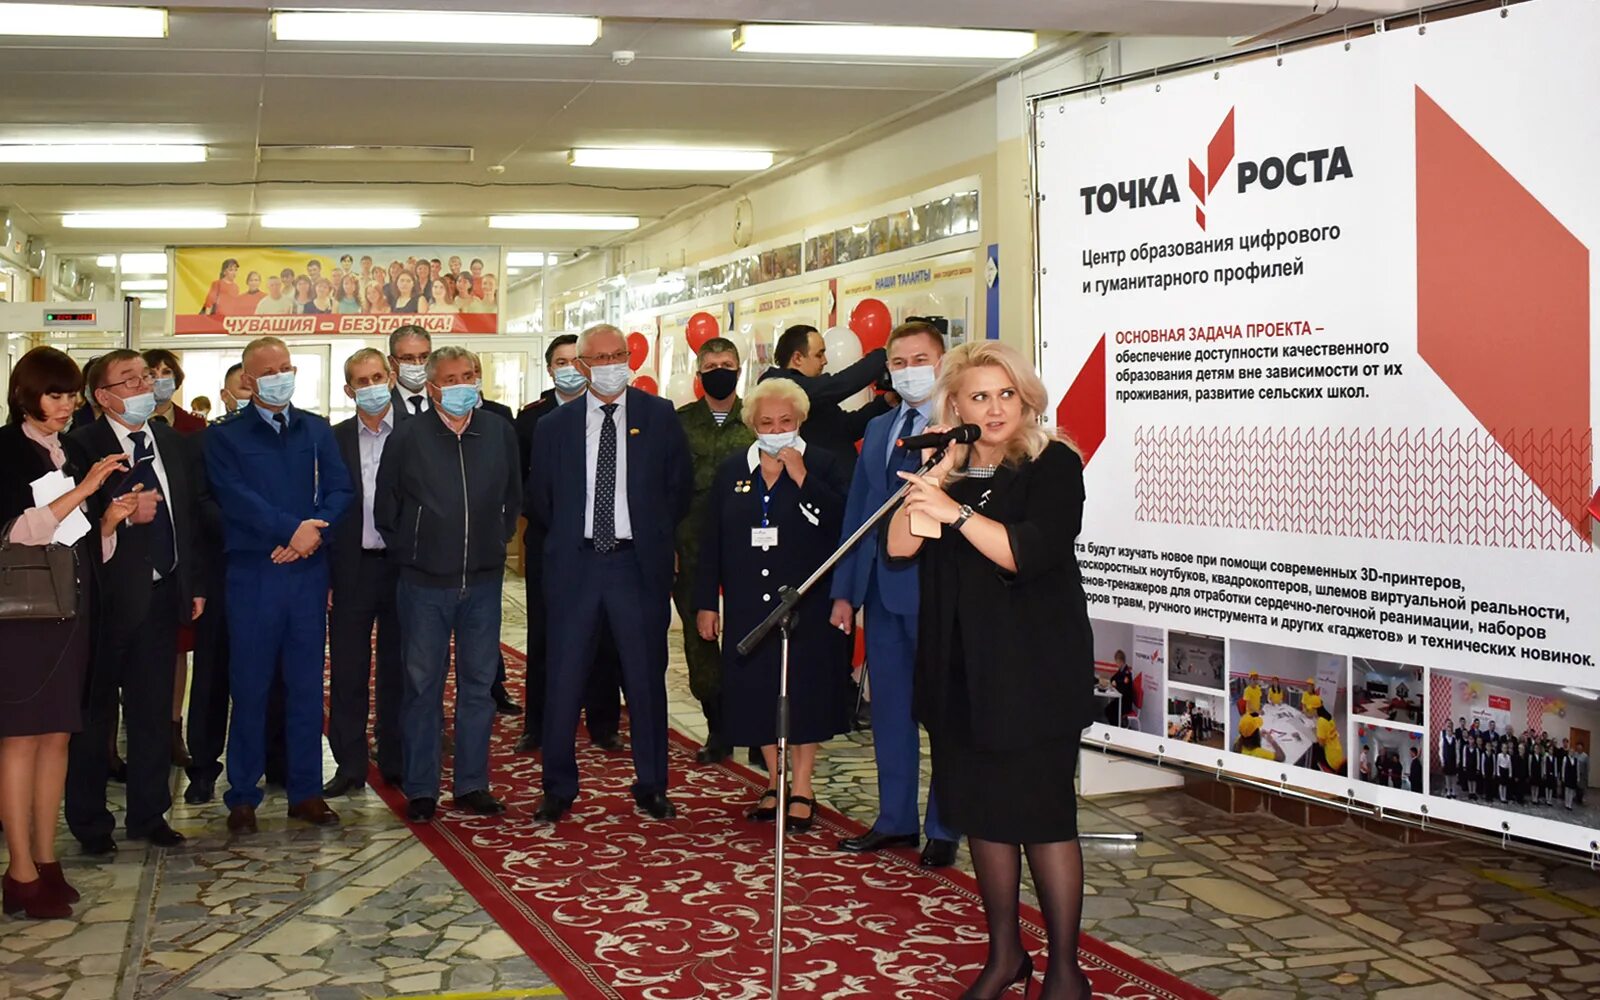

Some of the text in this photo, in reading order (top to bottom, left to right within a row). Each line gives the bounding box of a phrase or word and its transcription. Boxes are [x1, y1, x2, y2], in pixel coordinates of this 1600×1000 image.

[1080, 146, 1353, 215] ТОЧКА РОСТА
[1082, 225, 1341, 269] Центр образования цифрового
[1082, 257, 1304, 296] и гуманитарного профилей
[225, 317, 315, 332] ЧУВАШИЯ
[342, 317, 375, 331] БЕЗ
[1115, 328, 1185, 344] ОСНОВНАЯ
[1188, 324, 1243, 342] ЗАДАЧА
[1246, 320, 1312, 338] ПРОЕКТА
[1115, 342, 1389, 363] обеспечение доступности качественного
[1115, 364, 1403, 384] образования детям вне зависимости от их
[1115, 386, 1370, 403] проживания, развитие сельских школ.
[1087, 541, 1116, 558] будут
[1118, 547, 1159, 560] изучать
[1161, 551, 1194, 564] новое
[1196, 554, 1217, 567] при
[1220, 556, 1267, 571] помощи
[1270, 561, 1358, 580] современных
[1360, 567, 1466, 592] 3D-принтеров,
[1150, 567, 1209, 584] ноутбуков,
[1211, 573, 1312, 596] квадрокоптеров,
[1315, 584, 1368, 600] шлемов
[1371, 590, 1466, 611] виртуальной
[1470, 600, 1570, 624] реальности,
[1170, 586, 1191, 598] для
[1193, 589, 1251, 605] отработки
[1254, 596, 1376, 620] сердечно-легочной
[1379, 610, 1474, 634] реанимации,
[1478, 621, 1547, 640] наборов
[1112, 595, 1146, 611] травм,
[1149, 600, 1192, 615] ручного
[1194, 606, 1268, 625] инструмента
[1270, 616, 1279, 626] и
[1281, 617, 1324, 633] других
[1327, 624, 1404, 643] «гаджетов»
[1407, 634, 1417, 644] и
[1420, 633, 1517, 657] технических
[1520, 647, 1596, 667] новинок.
